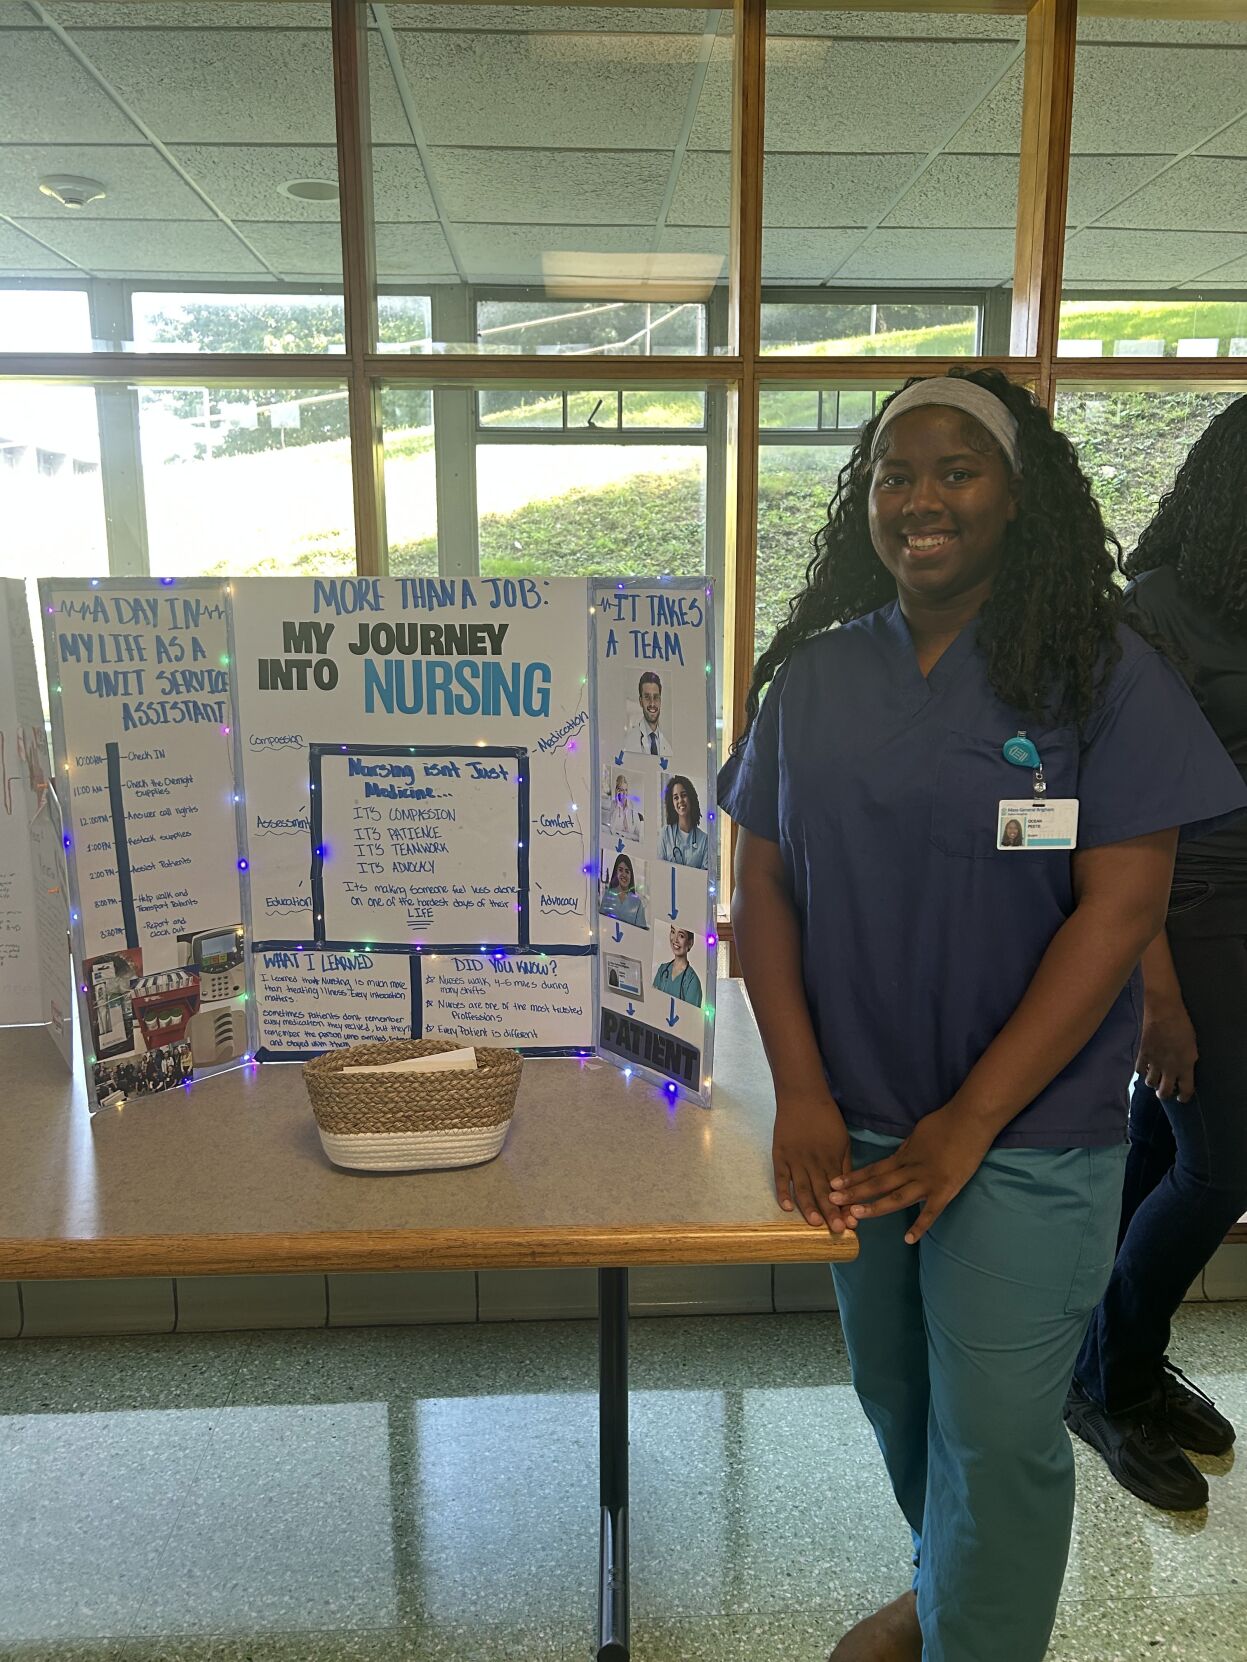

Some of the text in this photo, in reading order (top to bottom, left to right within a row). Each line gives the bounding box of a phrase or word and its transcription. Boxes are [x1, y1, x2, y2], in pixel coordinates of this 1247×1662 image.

[313, 578, 550, 615] MORE THAN A JOB:
[93, 595, 200, 630] A DAY IN
[613, 593, 703, 628] IT TAKES
[282, 621, 510, 656] MY JOURNEY
[59, 633, 207, 664] MY LIFE AS A
[606, 629, 684, 666] A TEAM
[84, 669, 229, 698] UNIT SERVICE
[258, 658, 552, 717] INTO NURSING
[122, 700, 226, 731] ASSISTANT
[537, 711, 589, 752] Medication
[348, 757, 415, 786] Nursing
[465, 761, 509, 781] Just
[150, 779, 163, 787] the
[389, 808, 456, 822] COMPASSION
[540, 814, 574, 828] Comfort
[387, 825, 443, 841] PATIENCE
[391, 842, 450, 856] TEAMWORK
[392, 860, 435, 874] ADVOCACY
[174, 888, 188, 898] and
[375, 885, 407, 898] making
[452, 884, 467, 894] feel
[471, 885, 491, 894] less
[265, 897, 313, 908] Education
[367, 898, 384, 907] one
[386, 897, 396, 907] of
[398, 896, 415, 906] the
[417, 897, 449, 907] hardest
[453, 898, 475, 909] days
[477, 898, 486, 907] of
[490, 898, 509, 908] their
[540, 895, 579, 908] Advocacy
[407, 908, 434, 918] LIFE
[173, 917, 187, 926] and
[263, 953, 374, 972] WHAT I LEARNED
[451, 957, 558, 977] DID YOU KNOW?
[259, 973, 268, 982] I
[367, 980, 388, 988] much
[390, 980, 407, 990] more
[438, 974, 465, 985] Nurses
[467, 976, 491, 987] walk
[513, 979, 538, 989] miles
[541, 980, 570, 995] during
[264, 983, 283, 993] than
[286, 984, 319, 999] treating
[440, 986, 486, 997] many shifts
[437, 1000, 583, 1015] Nurses are one of the most trusted
[326, 1021, 343, 1032] they
[375, 1024, 389, 1032] but
[491, 1029, 502, 1037] is
[503, 1028, 538, 1039] different
[304, 1030, 317, 1038] the
[318, 1031, 342, 1040] person
[270, 1039, 284, 1047] and
[602, 1011, 697, 1081] PATIENT
